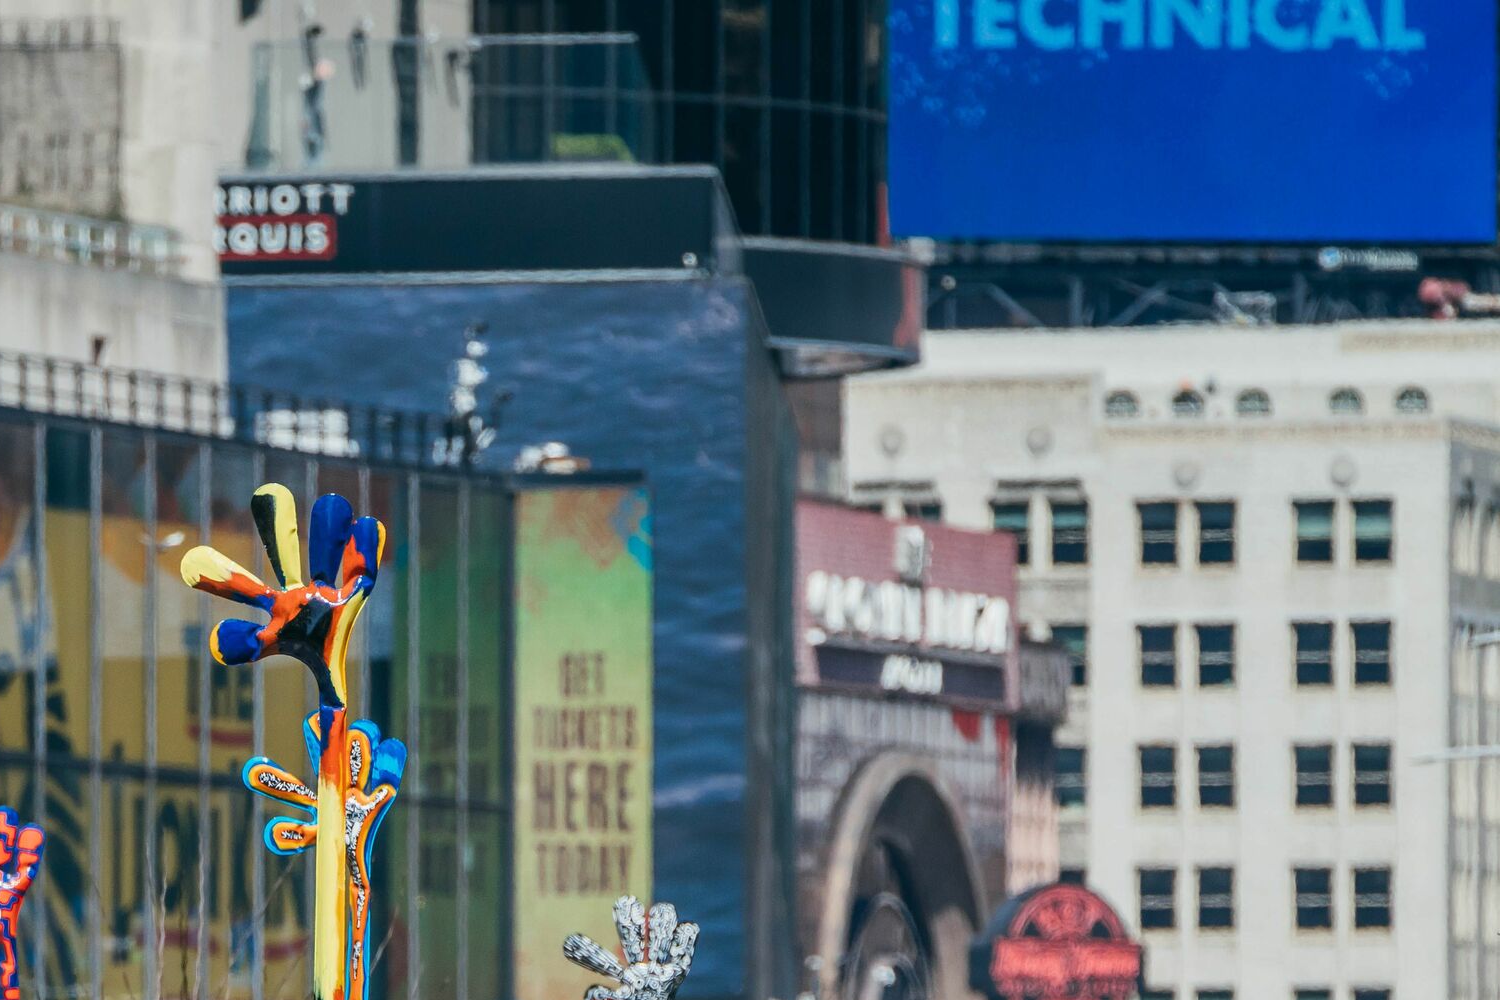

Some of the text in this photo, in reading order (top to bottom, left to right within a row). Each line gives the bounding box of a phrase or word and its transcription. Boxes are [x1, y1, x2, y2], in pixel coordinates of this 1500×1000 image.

[932, 0, 1426, 50] TECHNICAL
[534, 760, 631, 832] HERE
[536, 842, 631, 894] TODAY
